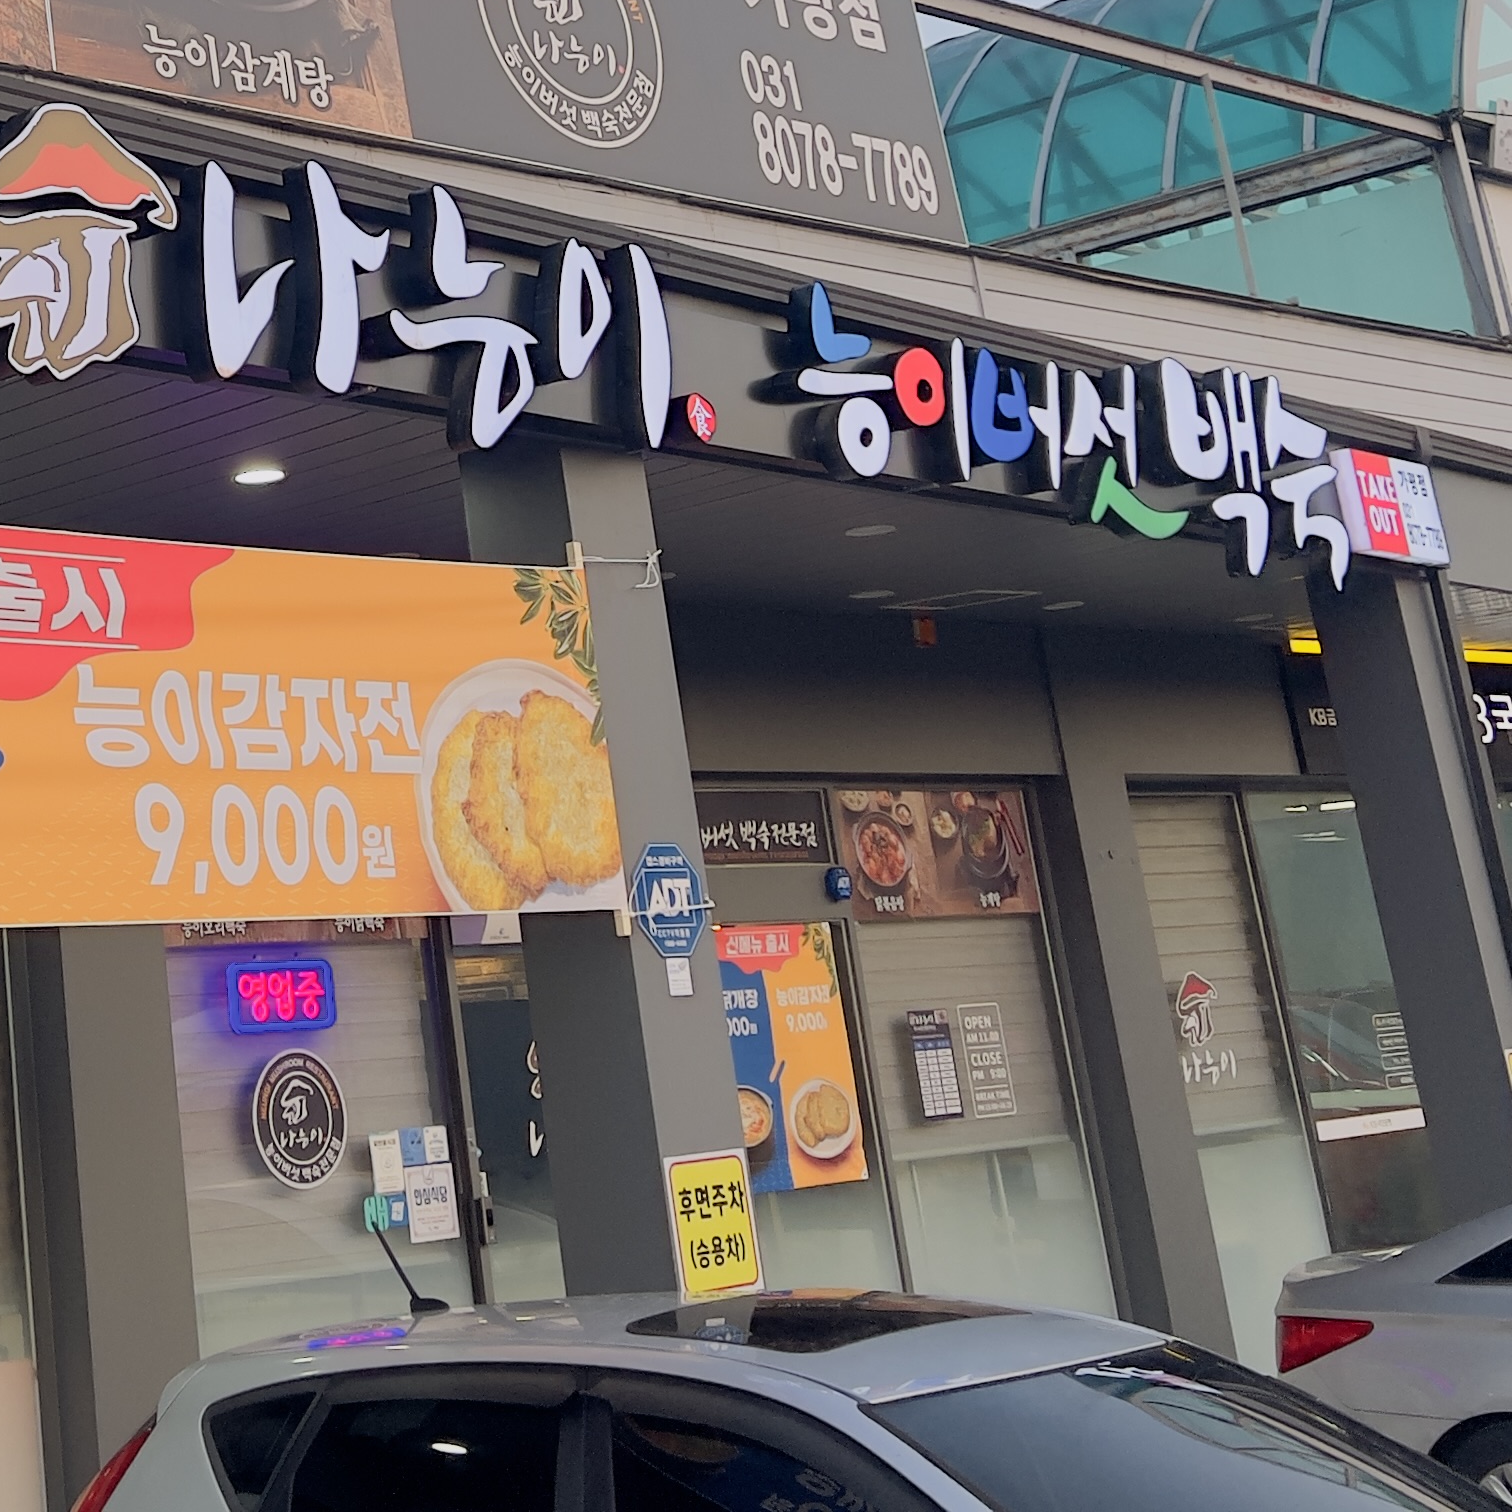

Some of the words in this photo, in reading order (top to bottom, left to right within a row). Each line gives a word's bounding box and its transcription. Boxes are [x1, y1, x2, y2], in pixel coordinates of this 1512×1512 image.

[142, 24, 335, 109] 능이삼계탕
[533, 30, 618, 77] 나능이
[504, 42, 578, 131] 능이버섯
[740, 49, 803, 112] 031
[752, 109, 939, 215] 8078-7789
[202, 159, 673, 450] 나능이
[1356, 469, 1398, 504] TAKE
[1369, 504, 1399, 536] OUT
[73, 663, 423, 775] 능이감자전
[649, 877, 691, 918] ADT
[726, 934, 763, 955] 신메뉴
[238, 970, 326, 1022] 영업중
[964, 1015, 992, 1030] OPEN
[970, 1051, 1003, 1067] CLOSE
[1181, 1049, 1237, 1085] 나능이
[678, 1180, 745, 1222] 후면주차
[690, 1232, 746, 1270] (승용차)
